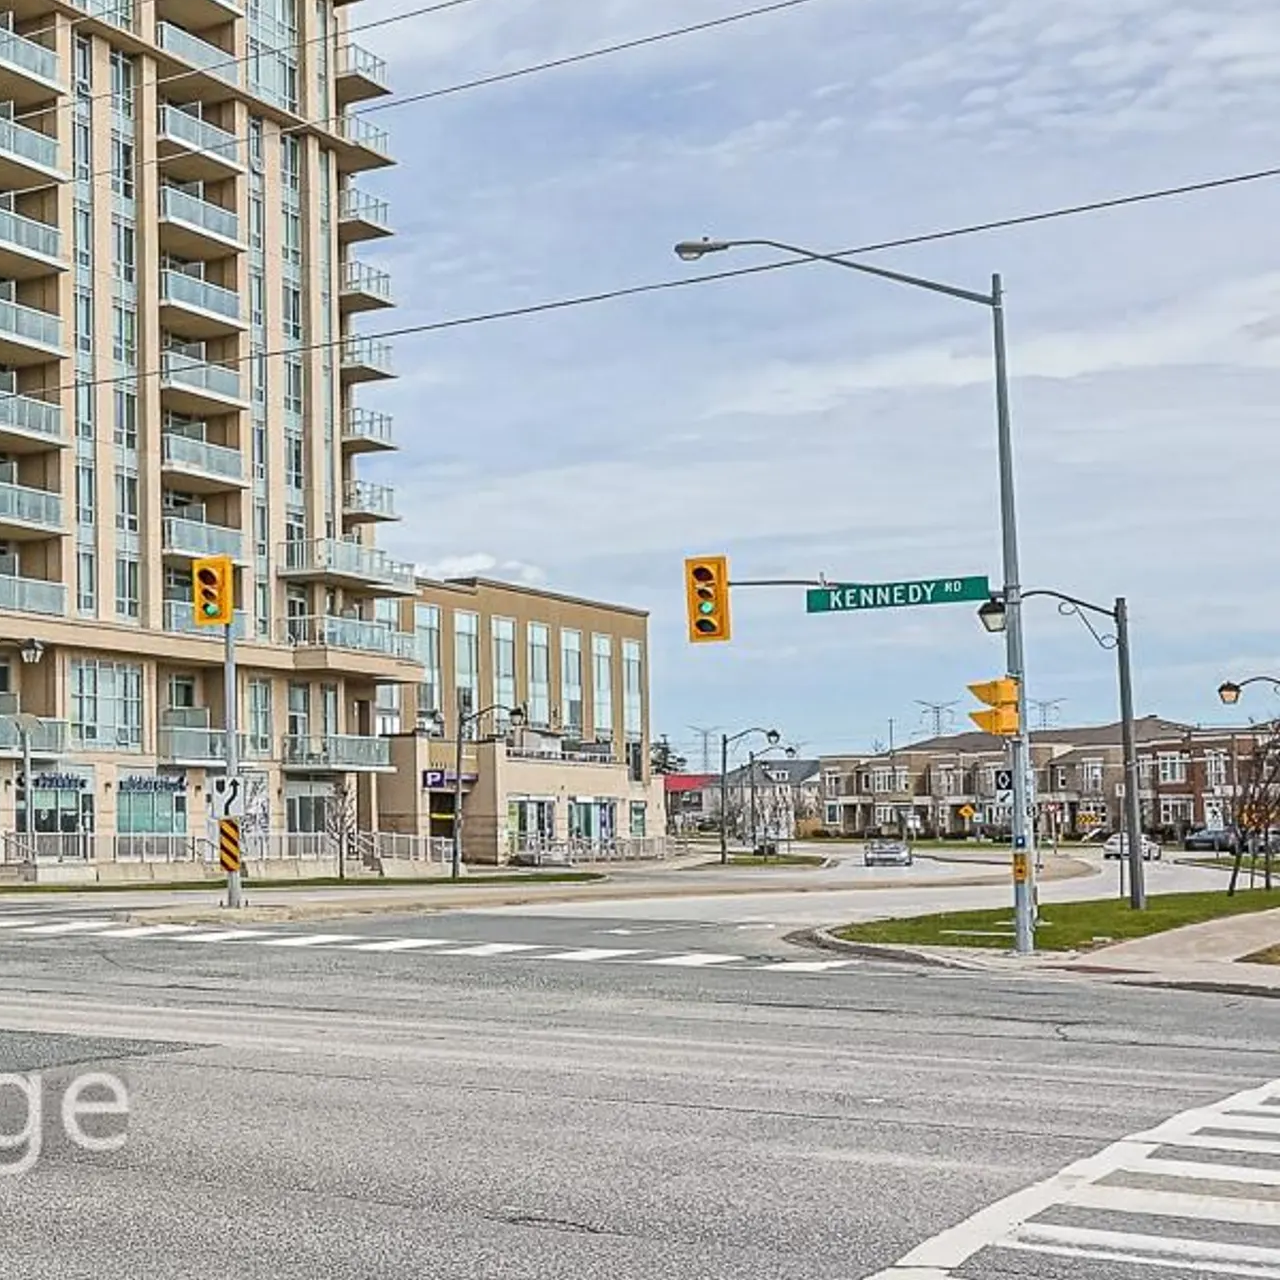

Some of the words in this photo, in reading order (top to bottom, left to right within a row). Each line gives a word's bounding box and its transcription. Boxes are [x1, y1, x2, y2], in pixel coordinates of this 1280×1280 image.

[830, 582, 936, 610] KENNEDY
[944, 580, 962, 593] RD
[426, 772, 441, 787] P
